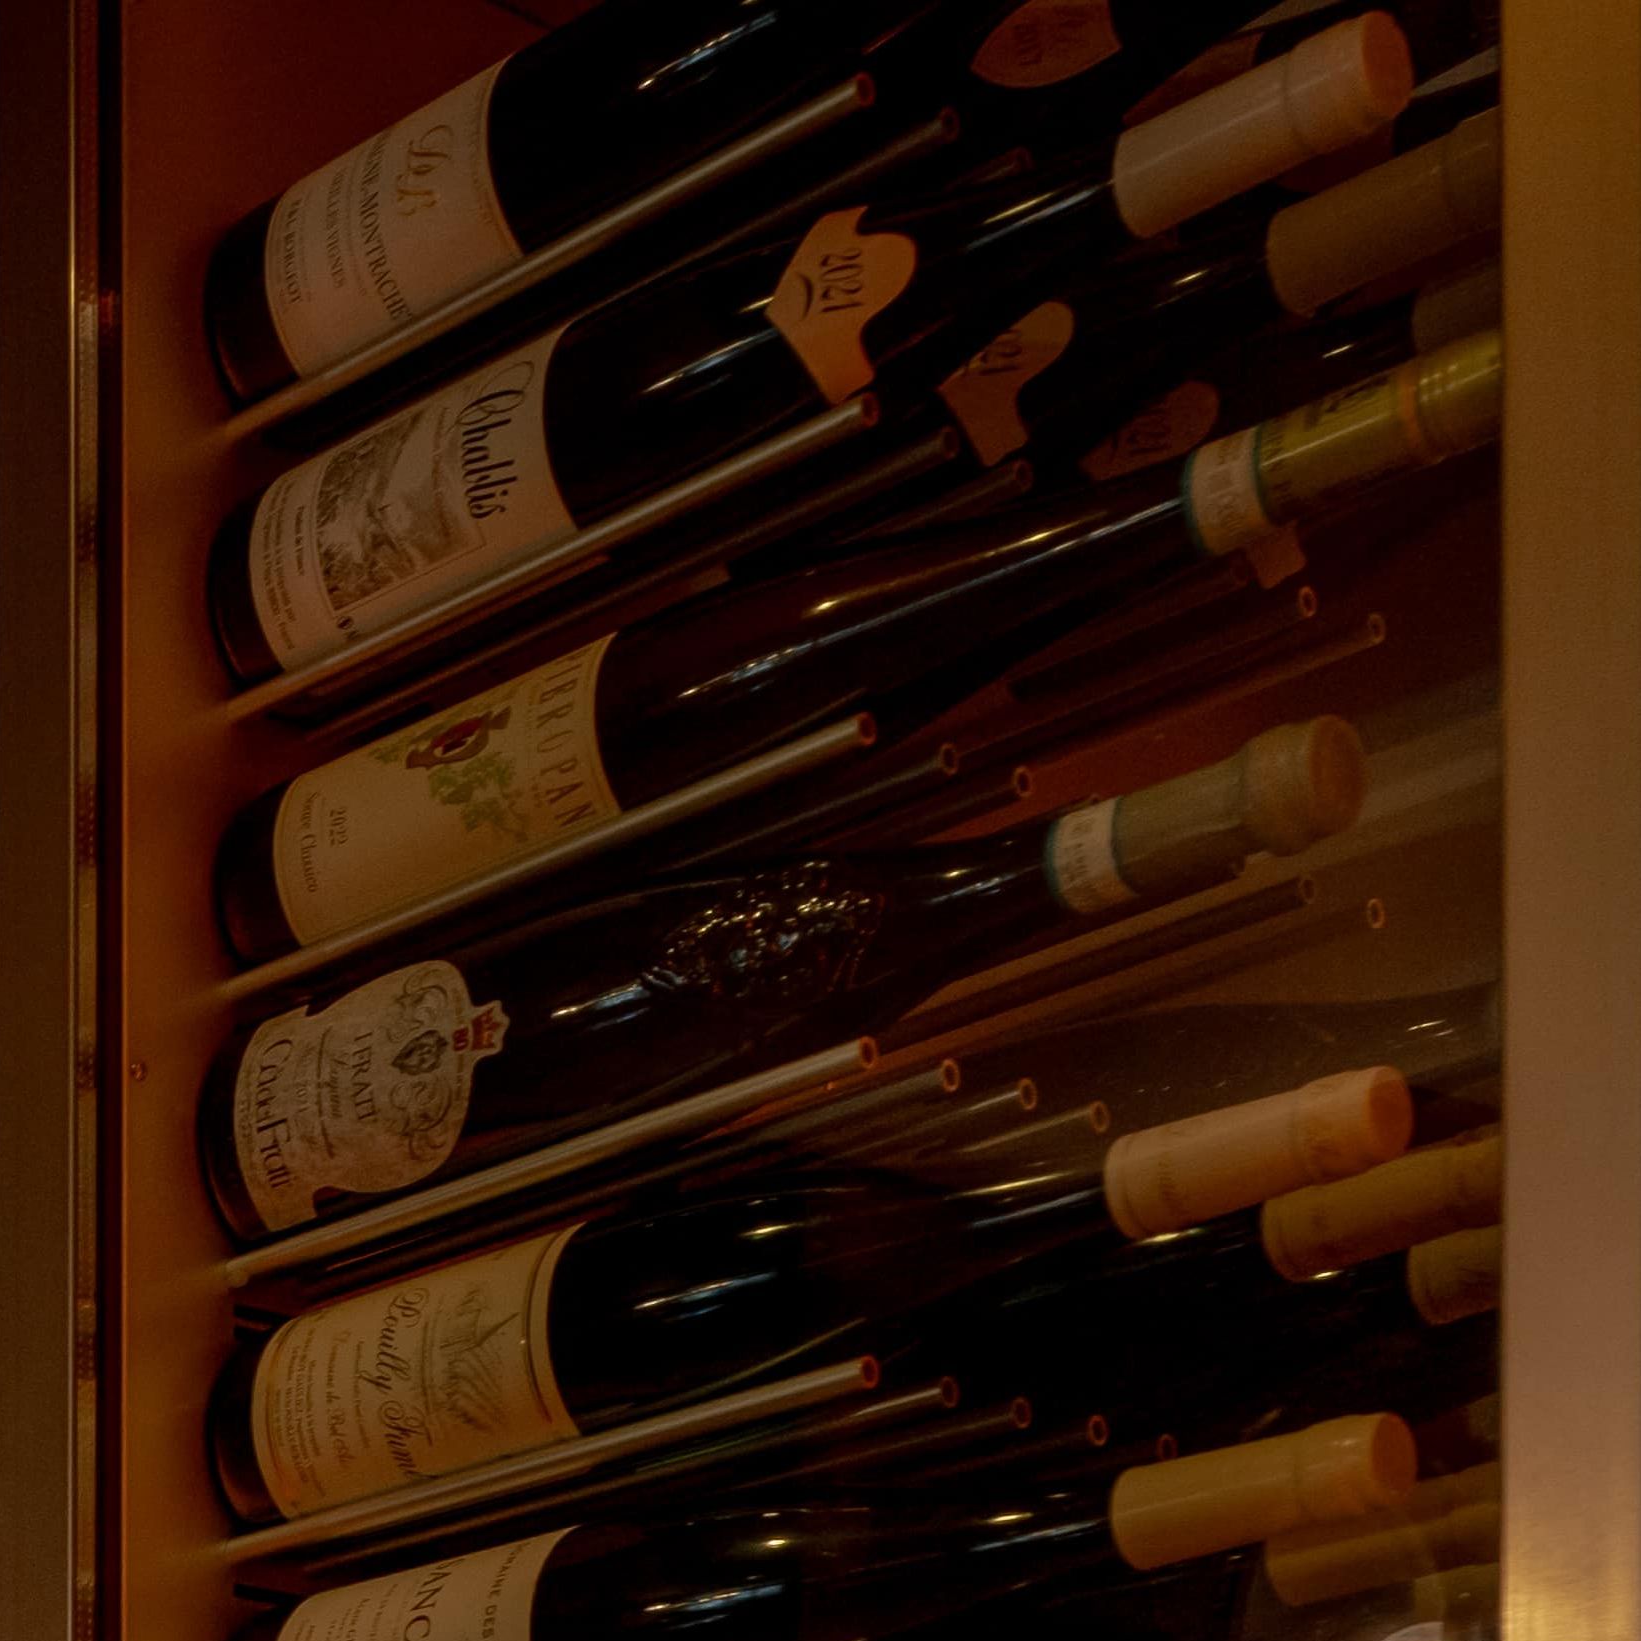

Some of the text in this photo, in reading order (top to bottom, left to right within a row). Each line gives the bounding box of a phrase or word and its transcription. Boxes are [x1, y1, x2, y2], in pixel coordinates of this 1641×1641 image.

[818, 247, 868, 316] 2021
[456, 361, 533, 519] Chablis
[297, 834, 321, 894] Classico
[358, 1287, 430, 1391] Pouilly
[480, 1604, 497, 1641] DES
